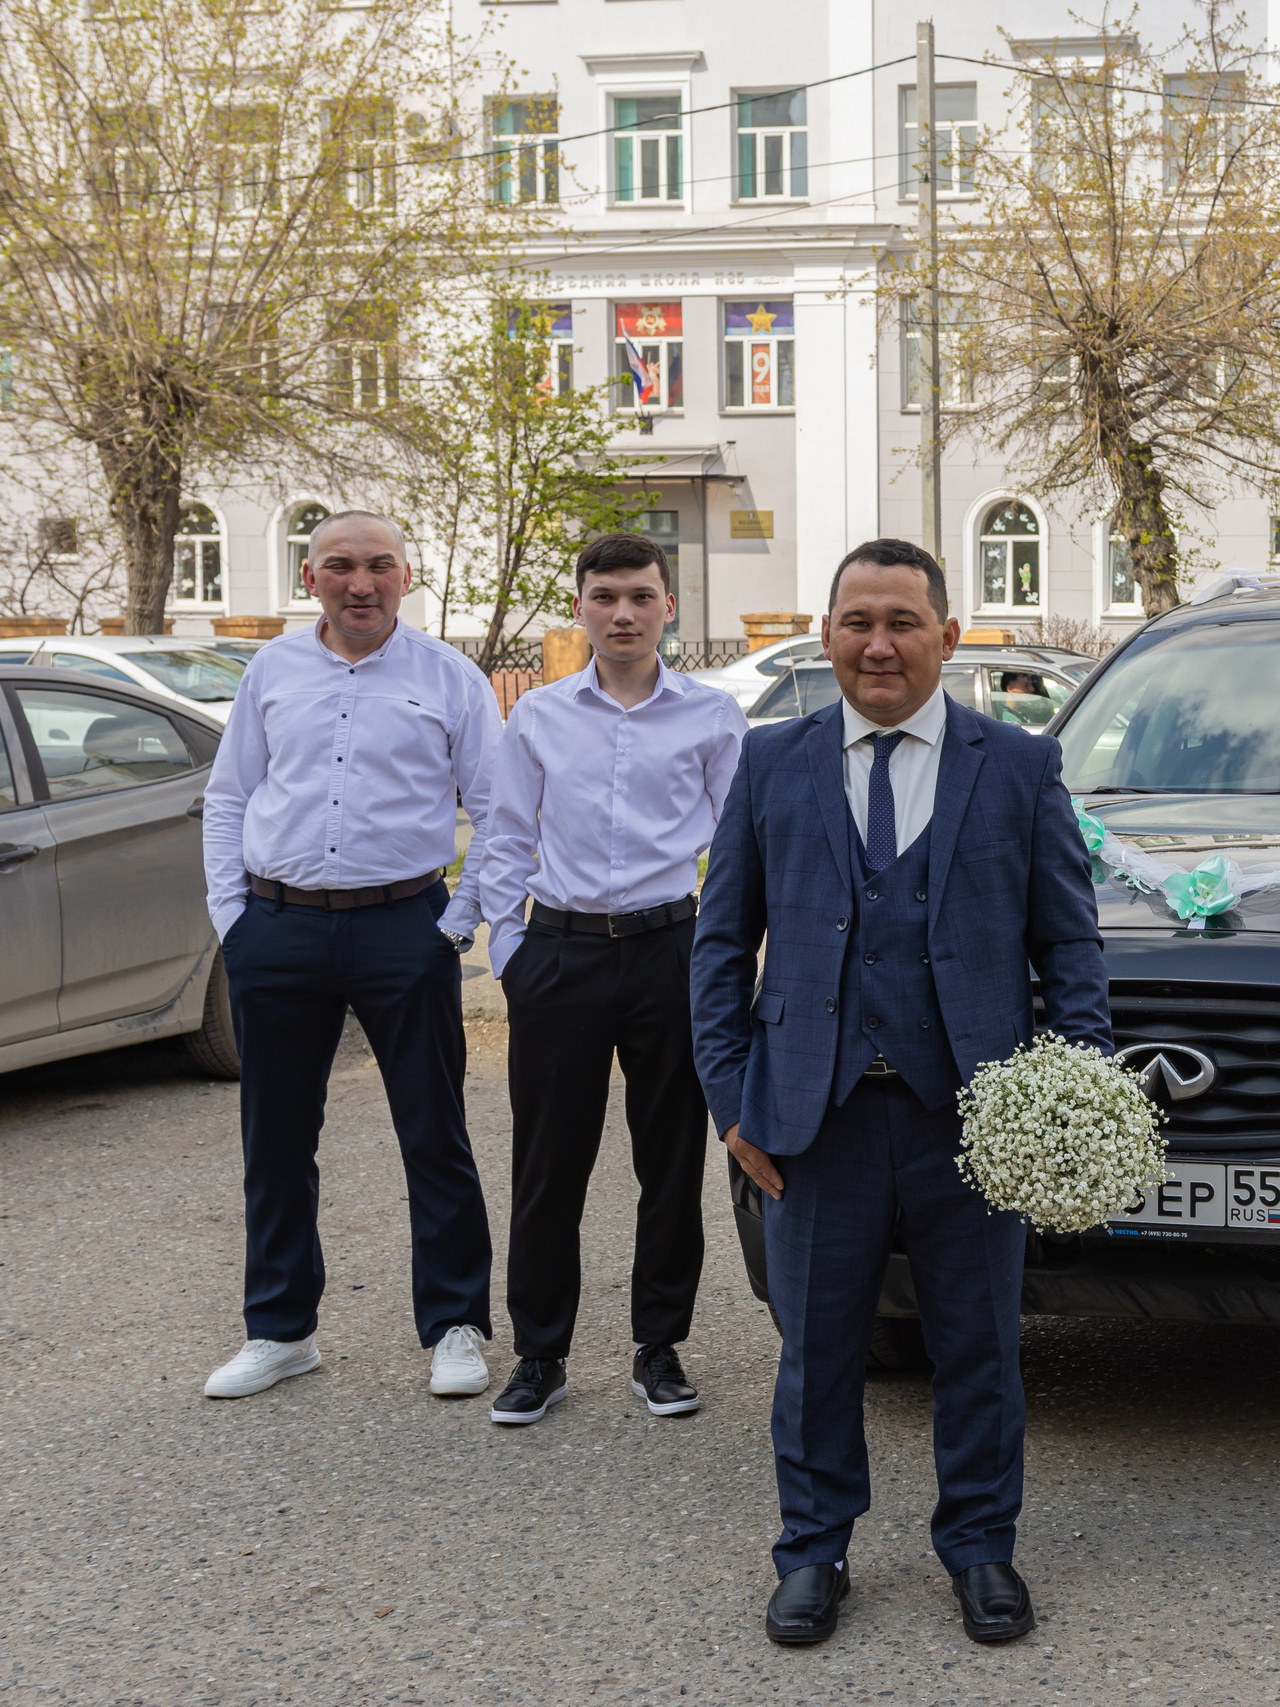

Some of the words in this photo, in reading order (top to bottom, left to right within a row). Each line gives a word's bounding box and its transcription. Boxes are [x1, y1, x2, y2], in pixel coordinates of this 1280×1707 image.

[640, 271, 700, 287] ШКОЛА
[752, 351, 770, 383] 9
[1231, 1208, 1266, 1222] RUS
